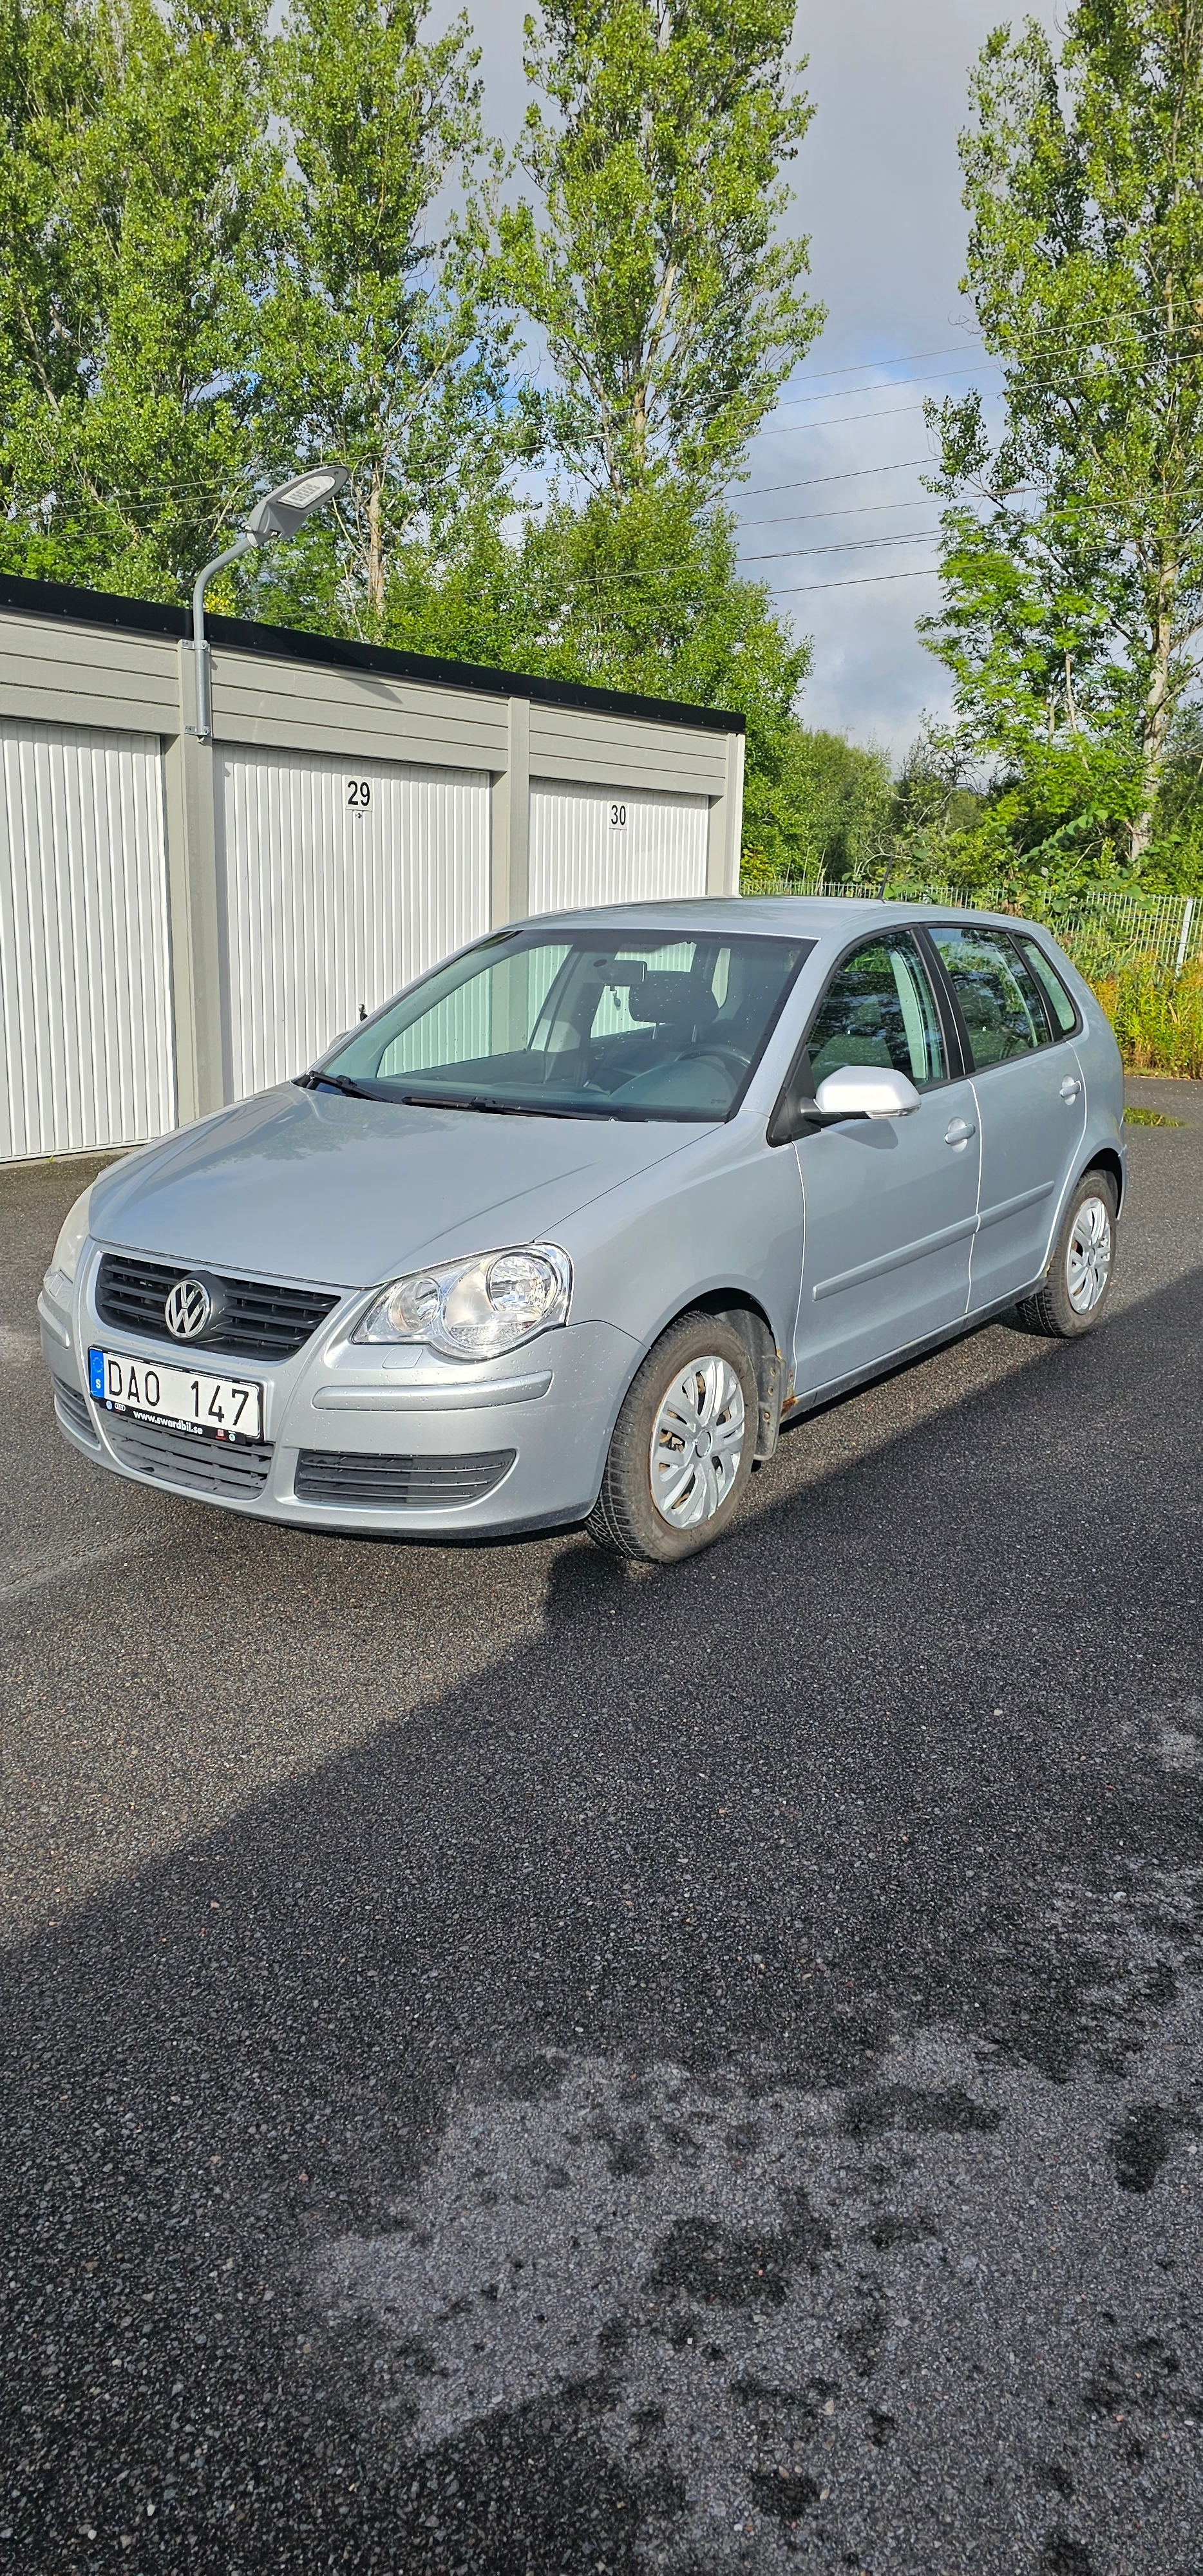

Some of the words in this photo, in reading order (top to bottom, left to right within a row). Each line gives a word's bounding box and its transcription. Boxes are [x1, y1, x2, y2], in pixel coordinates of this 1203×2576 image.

[347, 781, 370, 806] 29
[611, 804, 626, 826] 30
[166, 1279, 209, 1339] VW
[95, 1378, 101, 1389] S
[108, 1359, 160, 1406] DAO
[191, 1380, 249, 1426] 147
[133, 1410, 203, 1435] www.swardbil.se
